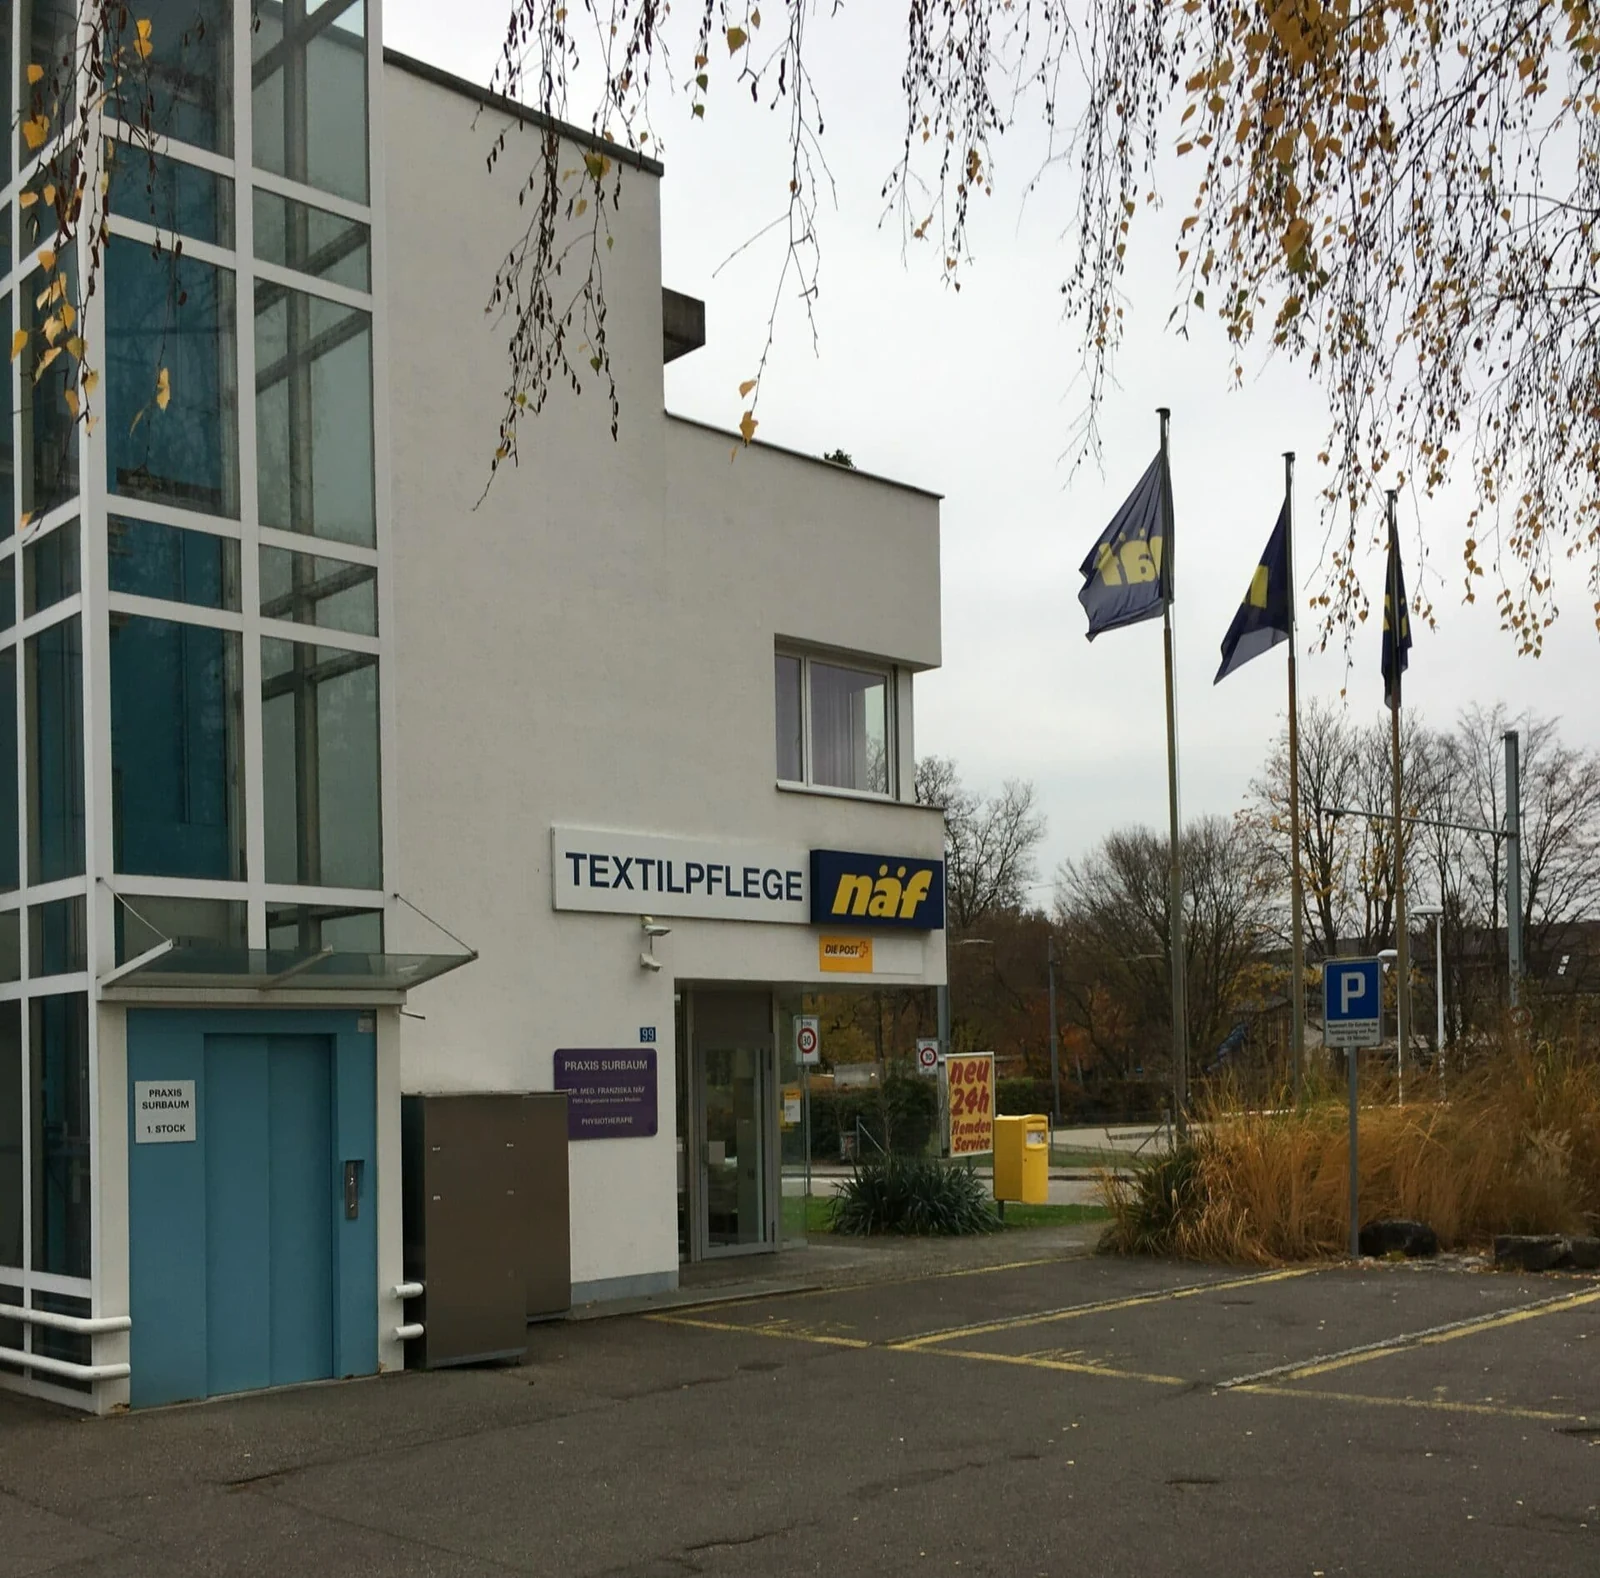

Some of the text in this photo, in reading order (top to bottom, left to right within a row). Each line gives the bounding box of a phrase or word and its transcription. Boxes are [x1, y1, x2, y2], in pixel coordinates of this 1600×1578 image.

[565, 852, 803, 901] TEXTILPFLEGE
[831, 864, 933, 919] näf
[825, 944, 859, 955] DIE POST
[1341, 972, 1366, 1013] P
[642, 1028, 655, 1041] 99
[803, 1035, 812, 1046] 30
[564, 1060, 648, 1071] PRAXIS SURBAUM
[950, 1061, 990, 1085] neu
[149, 1088, 182, 1098] PRAXIS
[142, 1100, 190, 1110] SURBAUM
[951, 1085, 990, 1116] 24h
[581, 1116, 633, 1126] PHYSIOTHERAPIE
[951, 1118, 992, 1136] Hemden
[147, 1124, 186, 1134] 1. STOCK
[954, 1135, 991, 1152] Service
